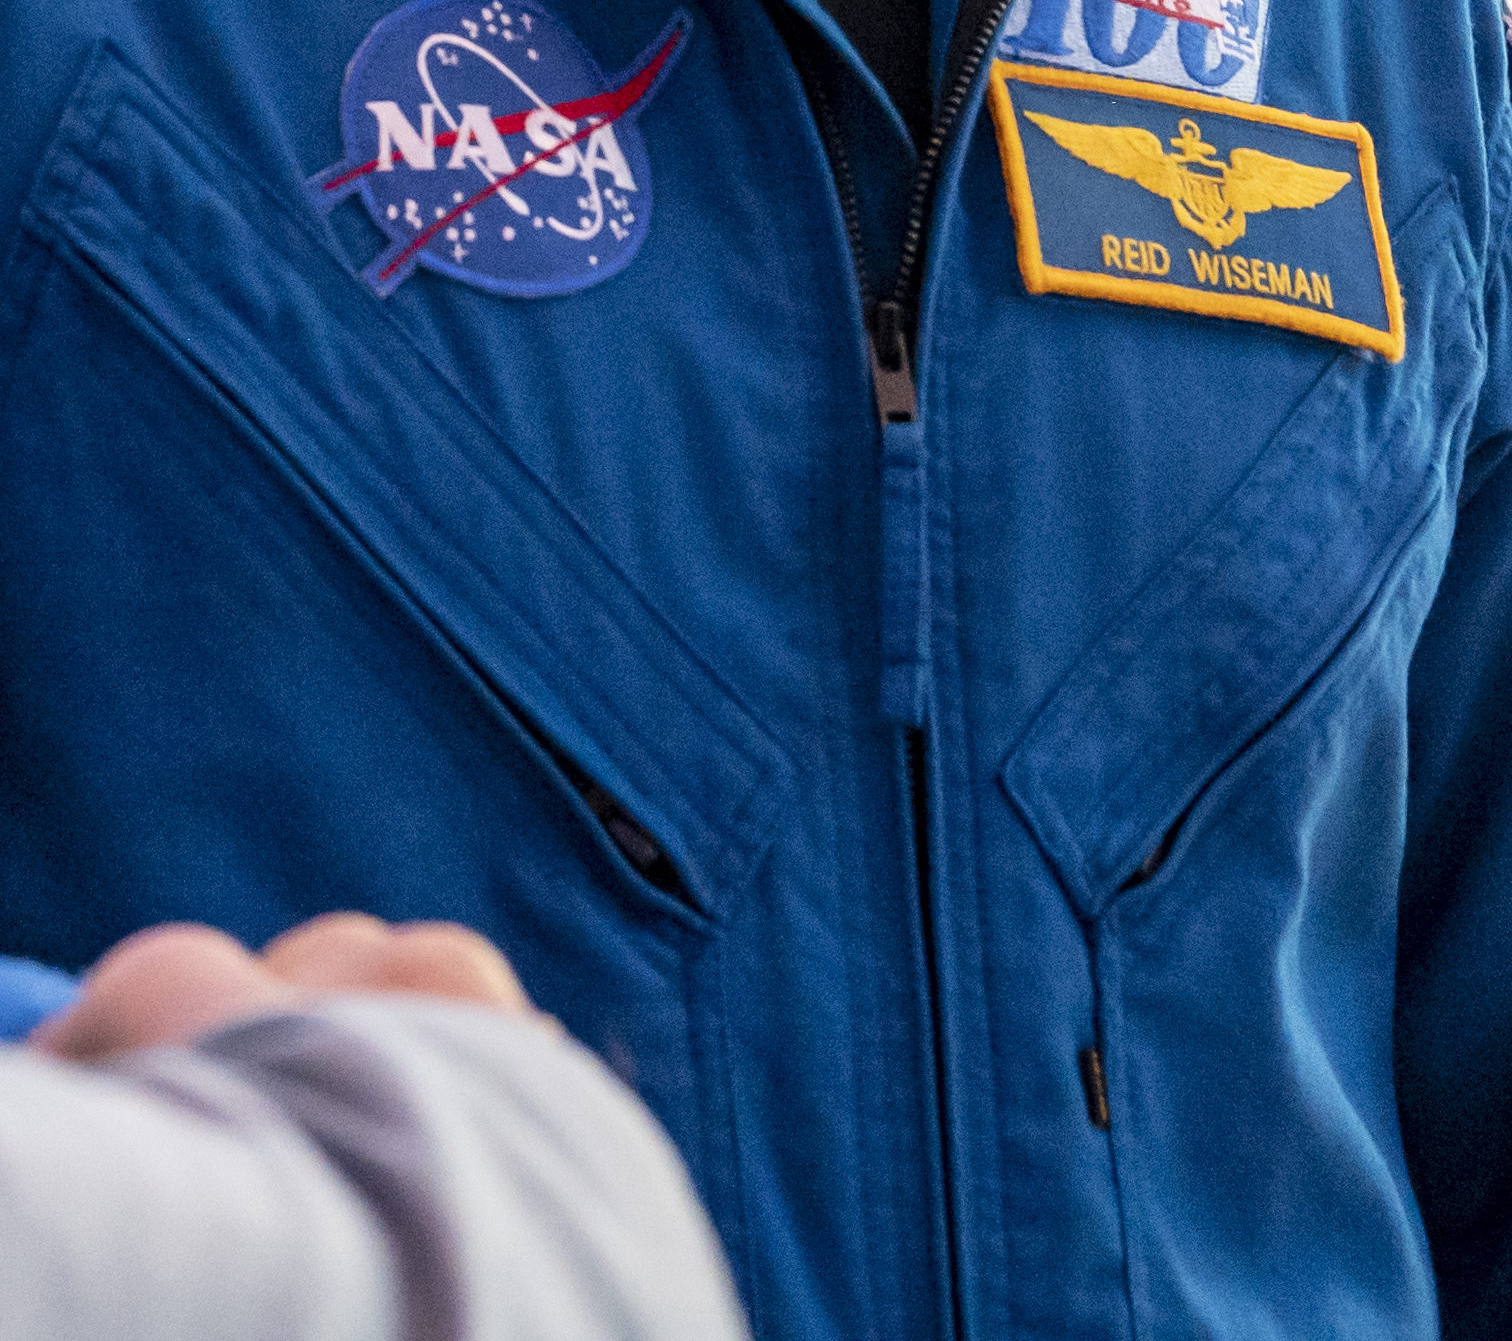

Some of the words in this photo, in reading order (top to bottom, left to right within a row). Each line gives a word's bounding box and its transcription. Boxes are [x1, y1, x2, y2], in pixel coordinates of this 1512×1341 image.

[365, 100, 638, 192] NASA
[1102, 234, 1171, 274] REID
[1188, 248, 1334, 310] WISEMAN
